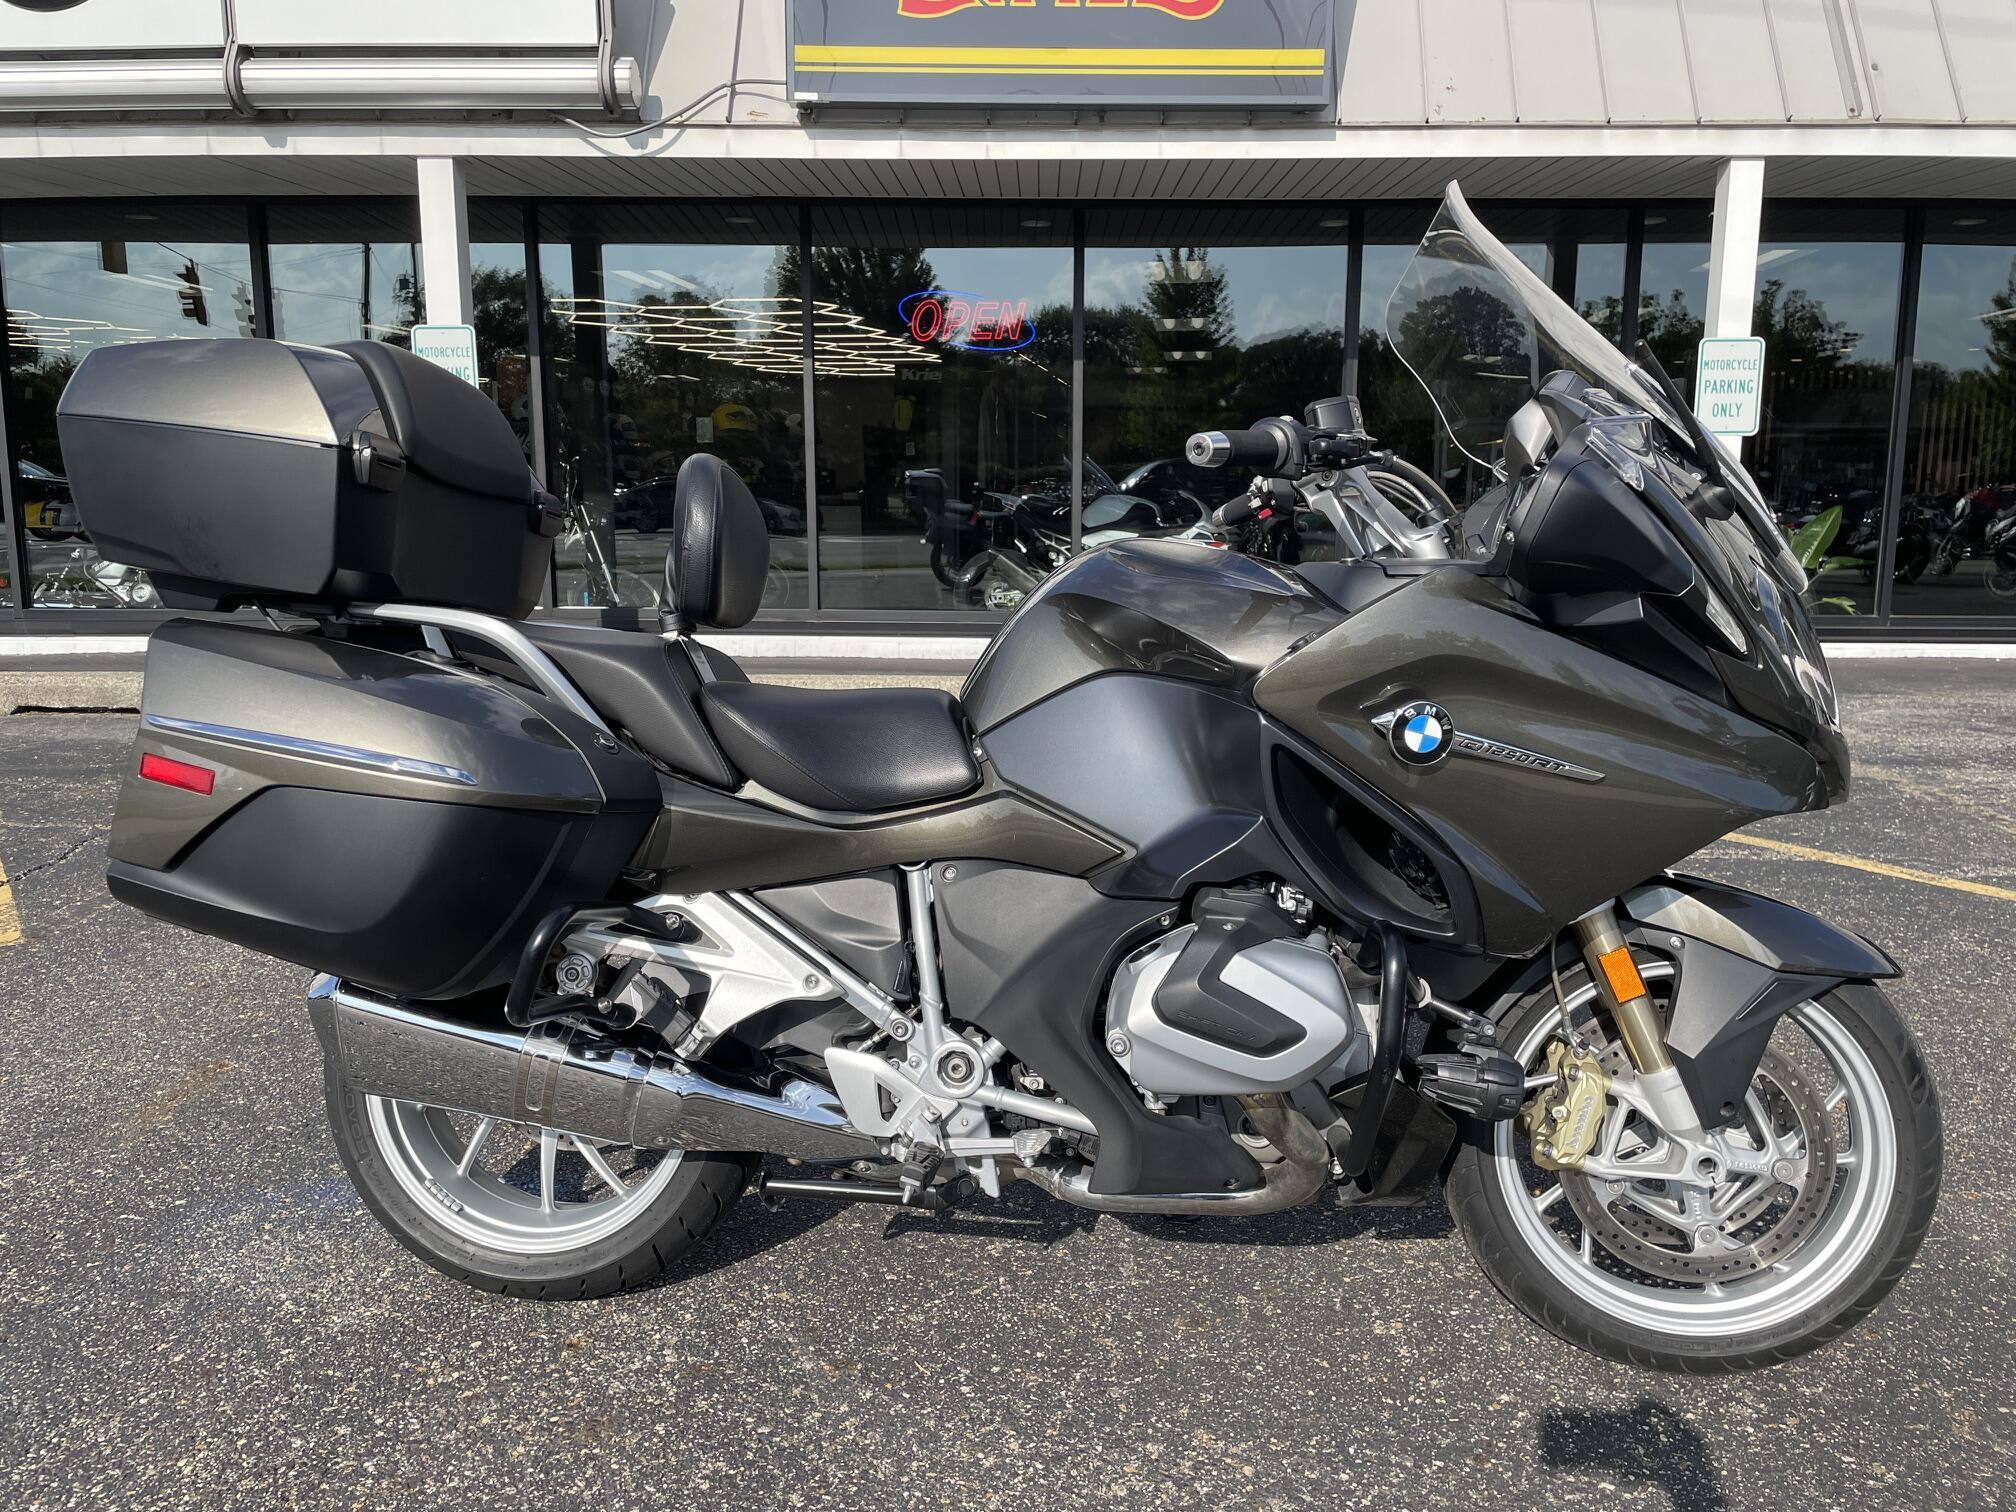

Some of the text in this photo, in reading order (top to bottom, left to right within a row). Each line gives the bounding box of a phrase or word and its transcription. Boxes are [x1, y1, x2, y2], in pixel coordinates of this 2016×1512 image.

[911, 299, 1027, 342] OPEN
[418, 347, 471, 358] MOTORCYCLE
[1703, 359, 1758, 371] MOTORCYCLE
[1704, 380, 1754, 394] PARKING
[1712, 403, 1742, 418] ONLY
[1404, 705, 1452, 730] BMW
